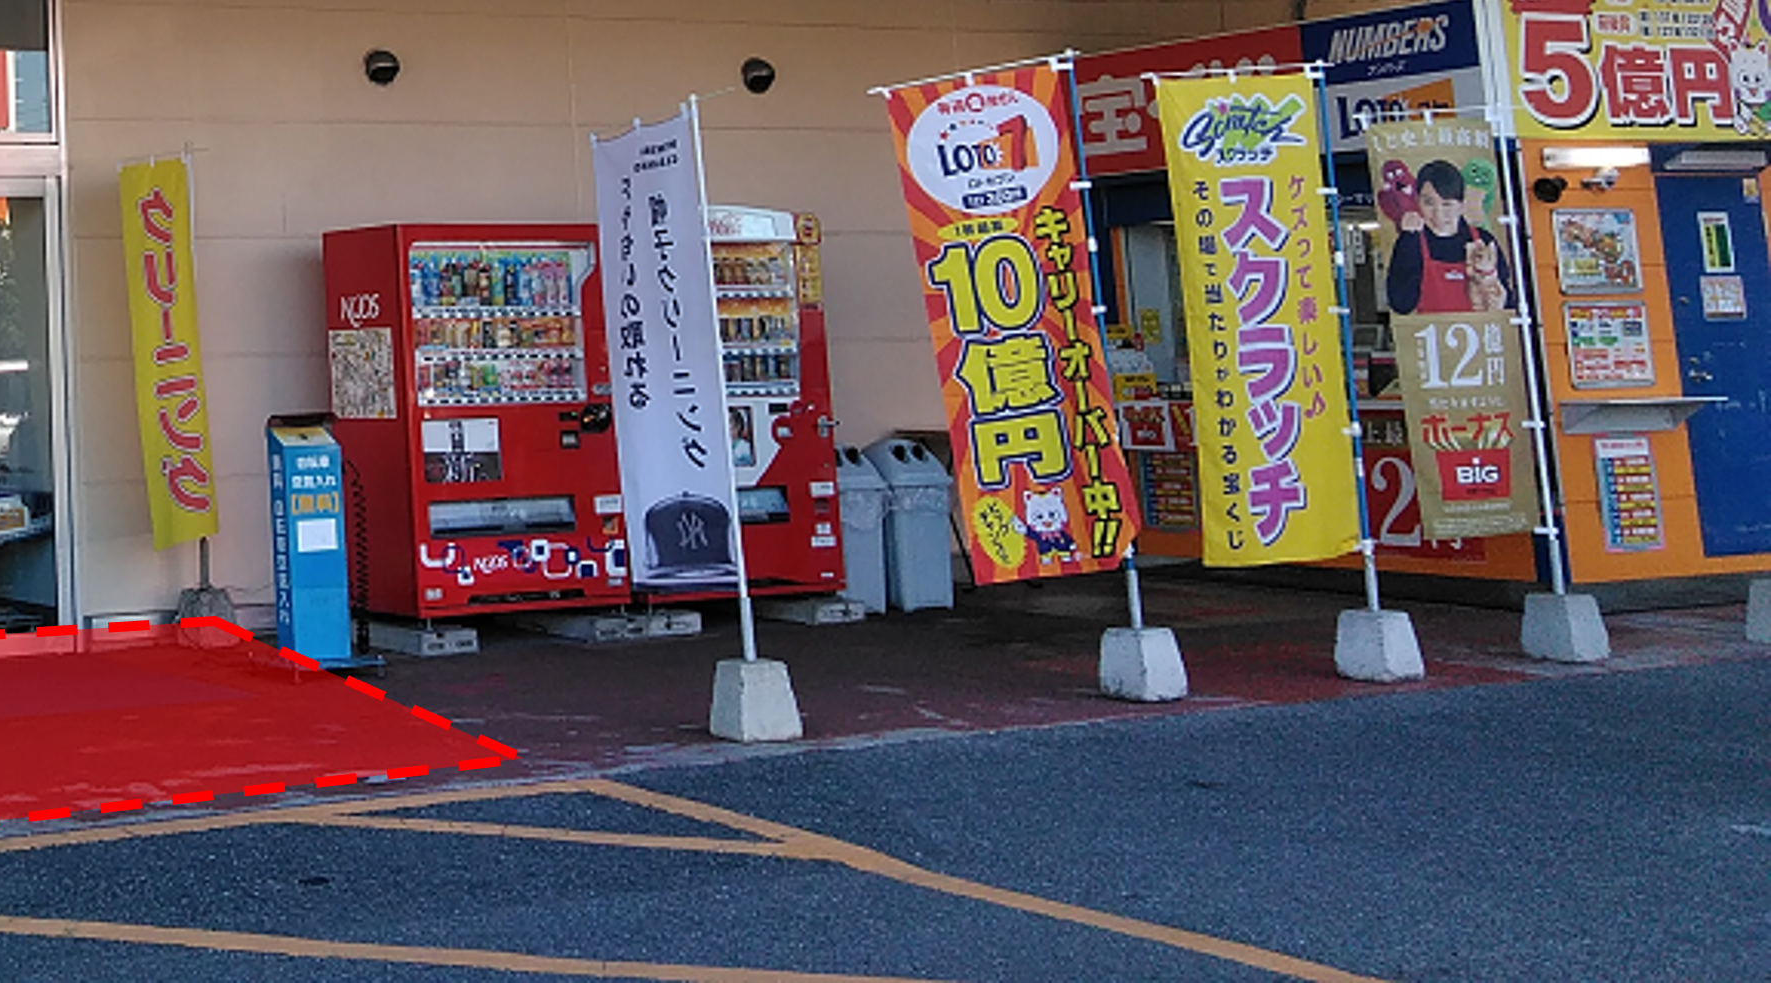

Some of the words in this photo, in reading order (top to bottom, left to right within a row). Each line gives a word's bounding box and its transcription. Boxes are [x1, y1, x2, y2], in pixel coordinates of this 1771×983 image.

[1328, 15, 1451, 65] NUMBERS
[1521, 14, 1735, 128] 5億円
[928, 236, 1069, 488] 10億円
[1033, 207, 1121, 557] キャリーオーバー中!!
[1220, 176, 1303, 543] スクラッチ
[1420, 412, 1515, 444] ボーナス
